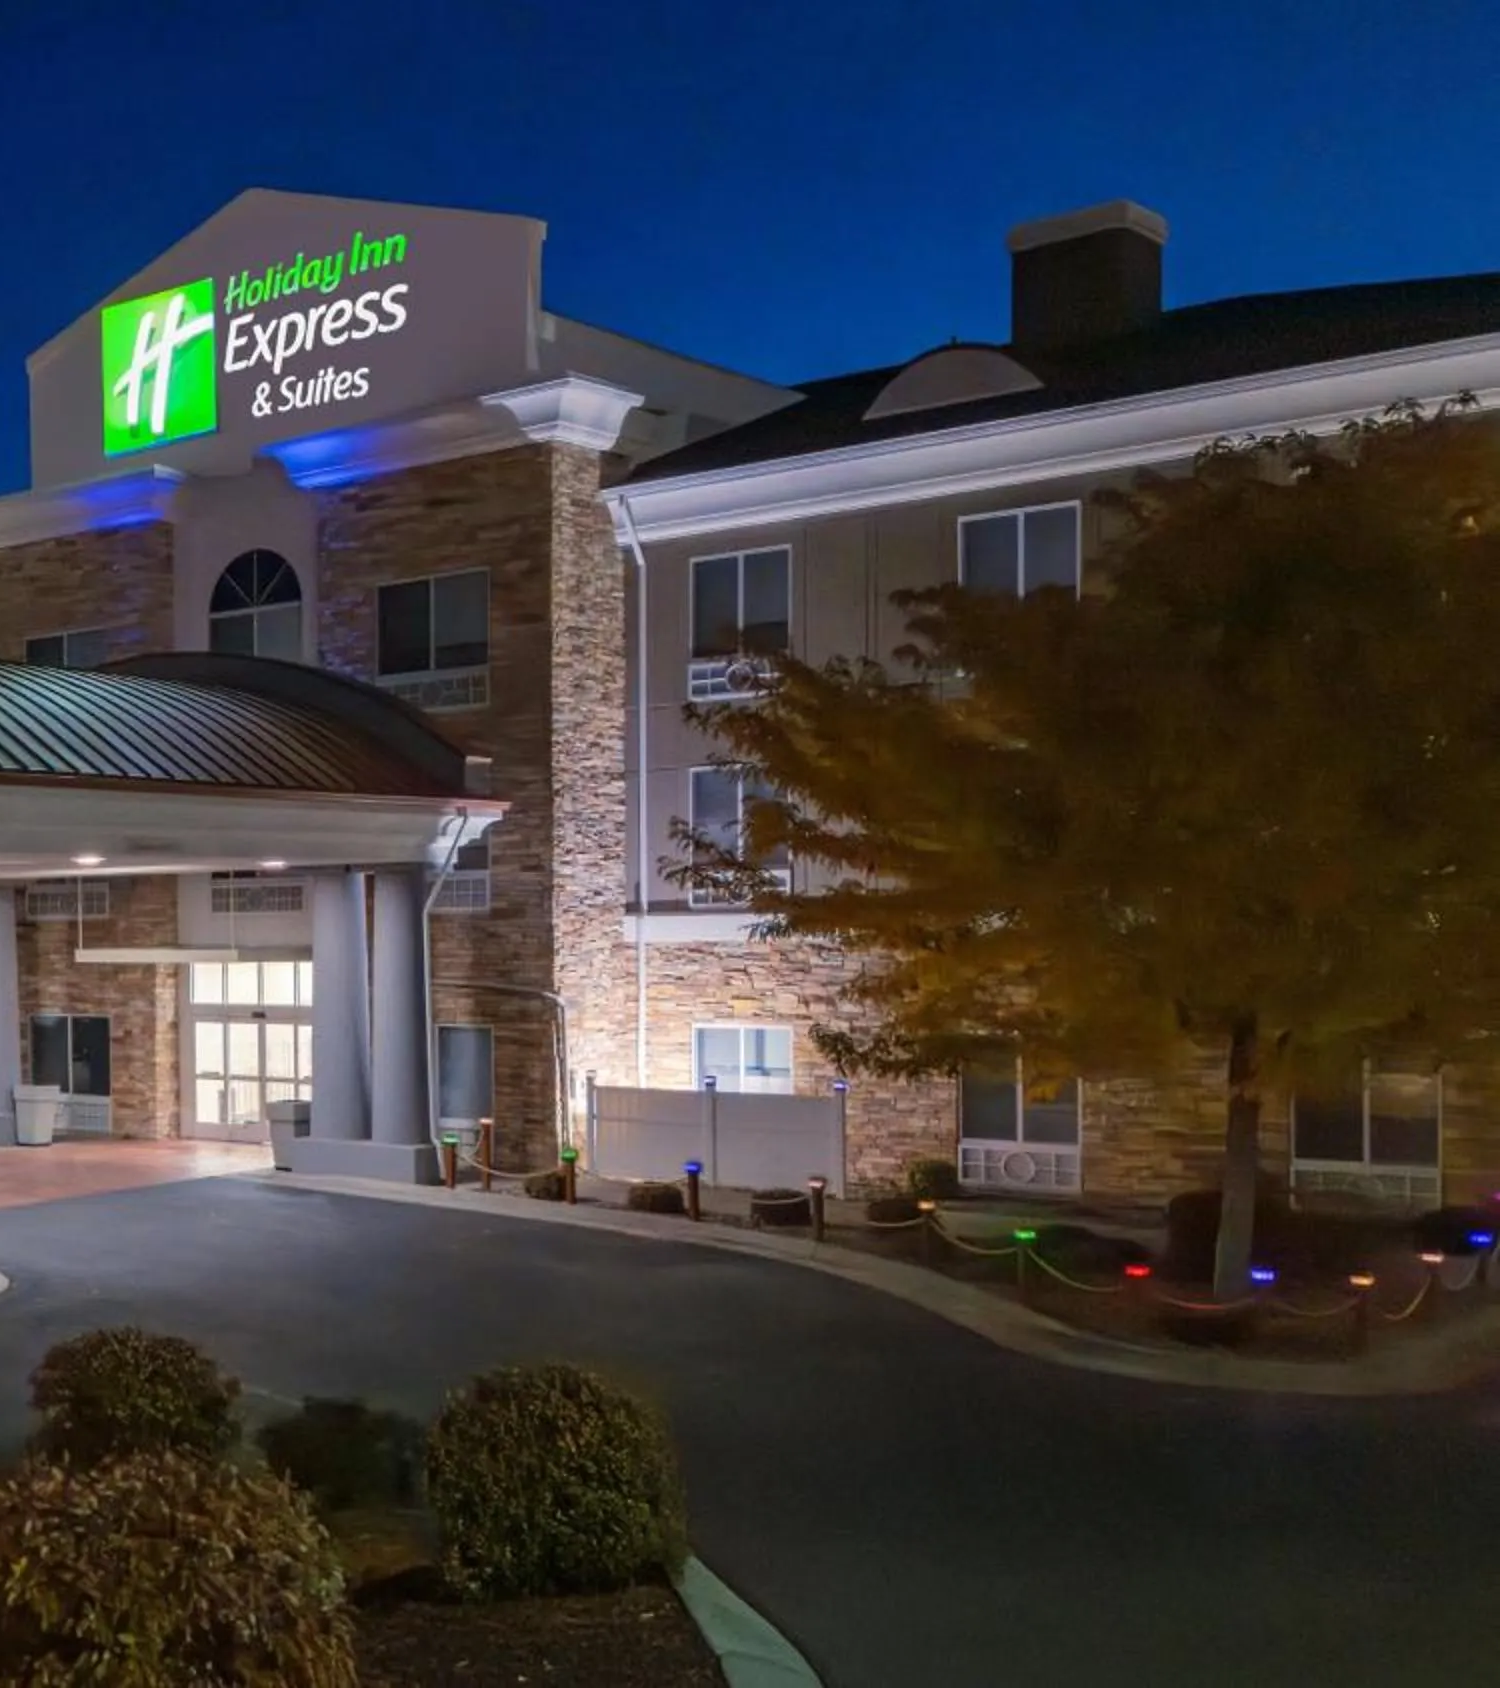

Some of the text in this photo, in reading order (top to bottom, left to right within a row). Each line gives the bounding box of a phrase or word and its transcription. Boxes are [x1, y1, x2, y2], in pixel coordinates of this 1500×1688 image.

[223, 231, 408, 315] Holiday Inn
[223, 283, 409, 375] Express
[251, 366, 370, 417] & Suites
